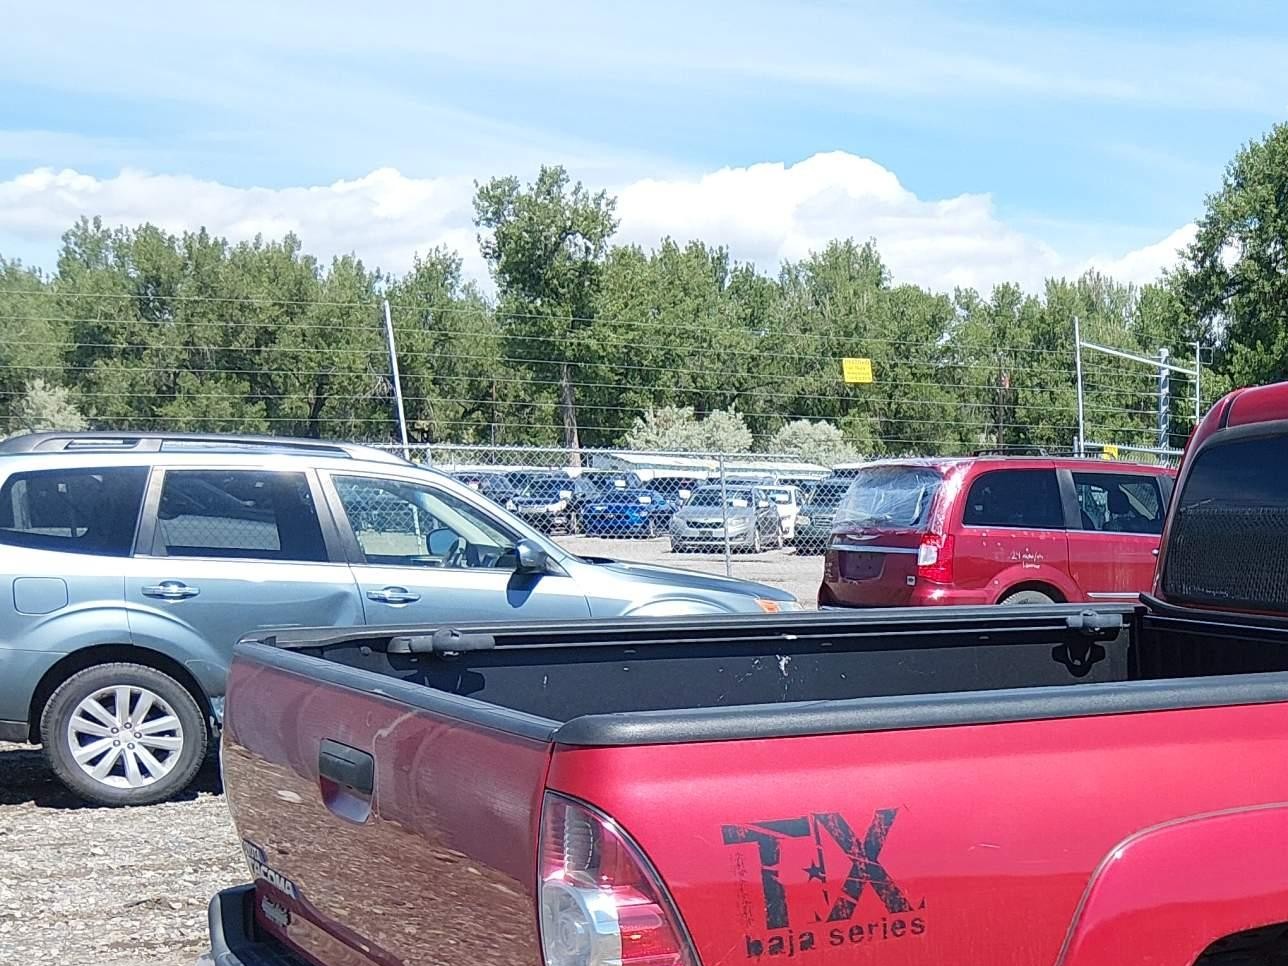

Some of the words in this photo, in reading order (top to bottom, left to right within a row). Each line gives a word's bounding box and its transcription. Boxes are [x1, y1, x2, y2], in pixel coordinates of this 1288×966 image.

[720, 807, 914, 930] TX
[745, 930, 816, 959] baja
[829, 917, 926, 946] series
